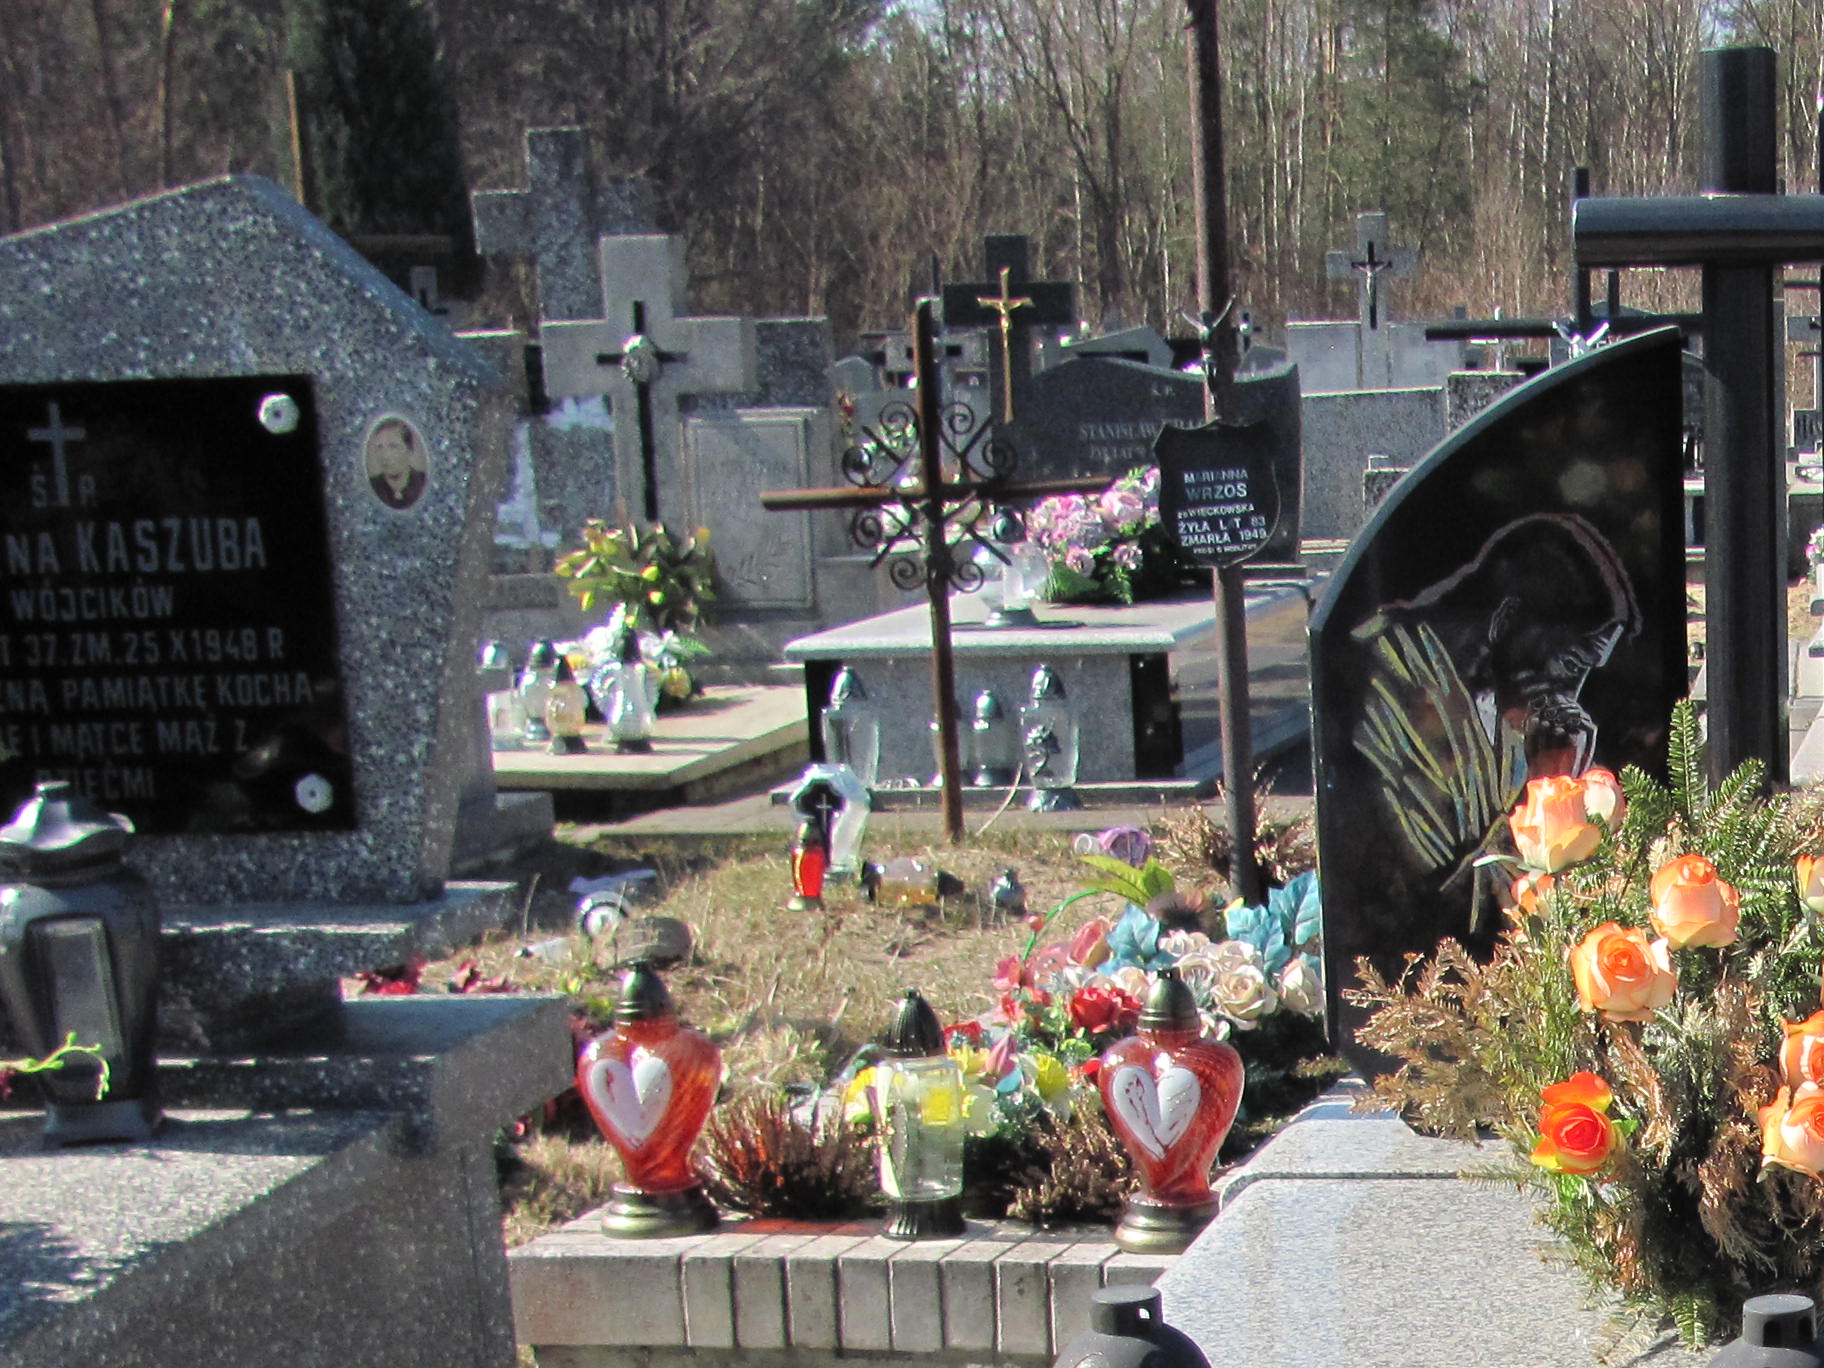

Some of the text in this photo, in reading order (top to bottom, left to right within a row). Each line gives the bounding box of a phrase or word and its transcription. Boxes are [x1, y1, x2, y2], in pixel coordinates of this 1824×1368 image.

[1183, 467, 1249, 484] MARIANNA
[1184, 482, 1248, 502] WRZOS
[76, 516, 267, 574] KASZUBA
[1180, 532, 1232, 549] ZMARŁA
[11, 577, 174, 622] WÓJCIKÓW
[62, 674, 207, 713] PAMIĄTKĘ
